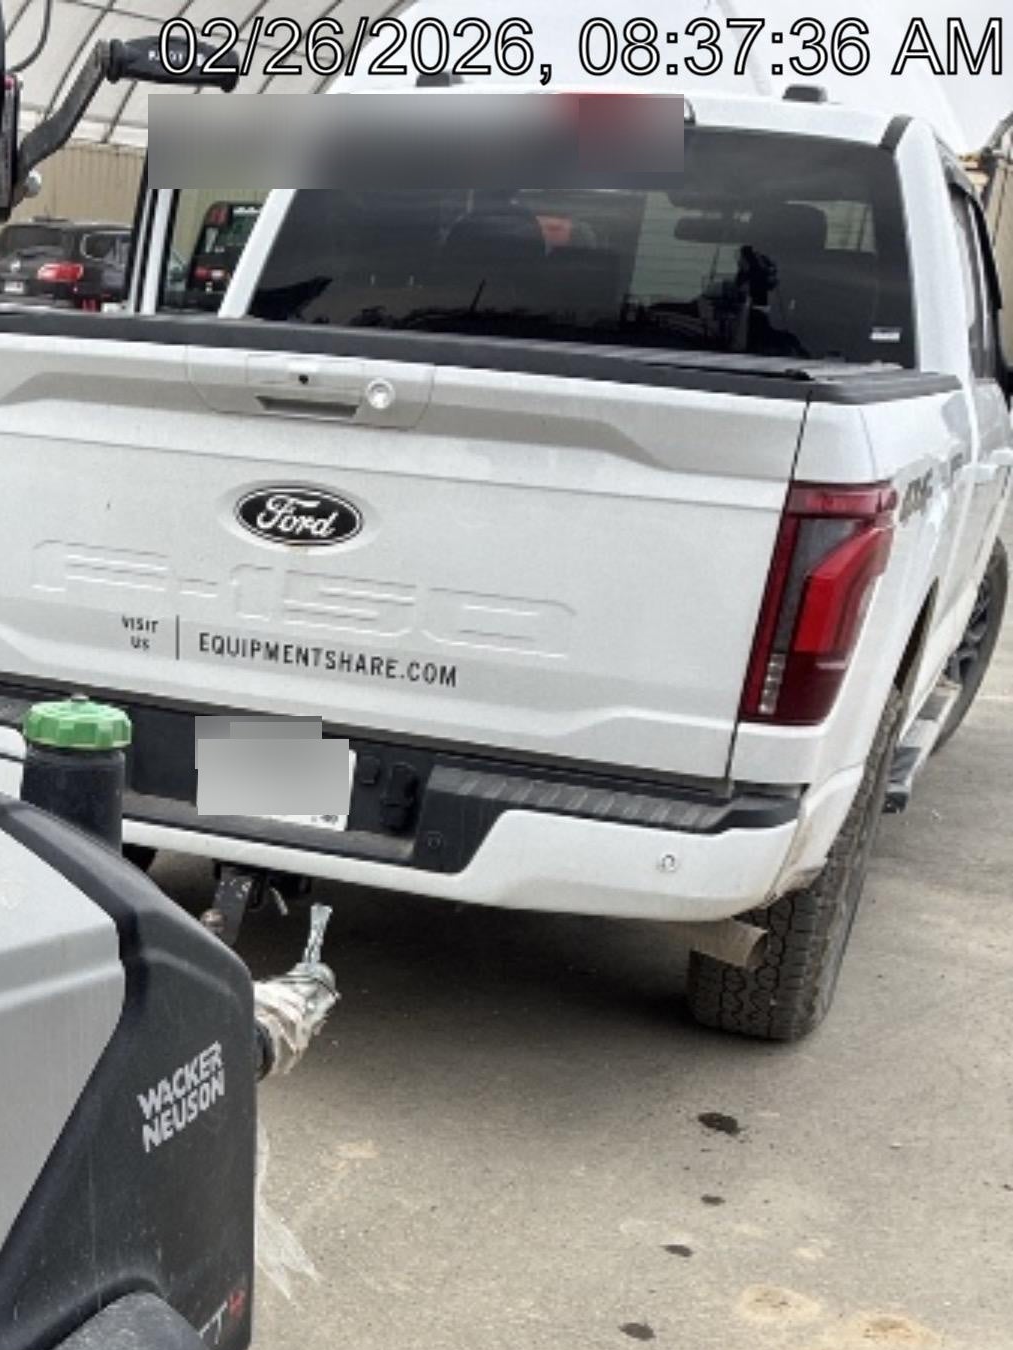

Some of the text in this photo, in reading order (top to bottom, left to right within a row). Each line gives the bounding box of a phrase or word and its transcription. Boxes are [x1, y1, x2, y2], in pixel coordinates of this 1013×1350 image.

[255, 493, 339, 539] Ford
[121, 614, 160, 634] VISIT
[130, 635, 151, 650] US
[198, 631, 458, 688] EQUIPMENTSHARE.COM
[136, 1040, 224, 1120] WACKER
[142, 1067, 225, 1153] NEUSON
